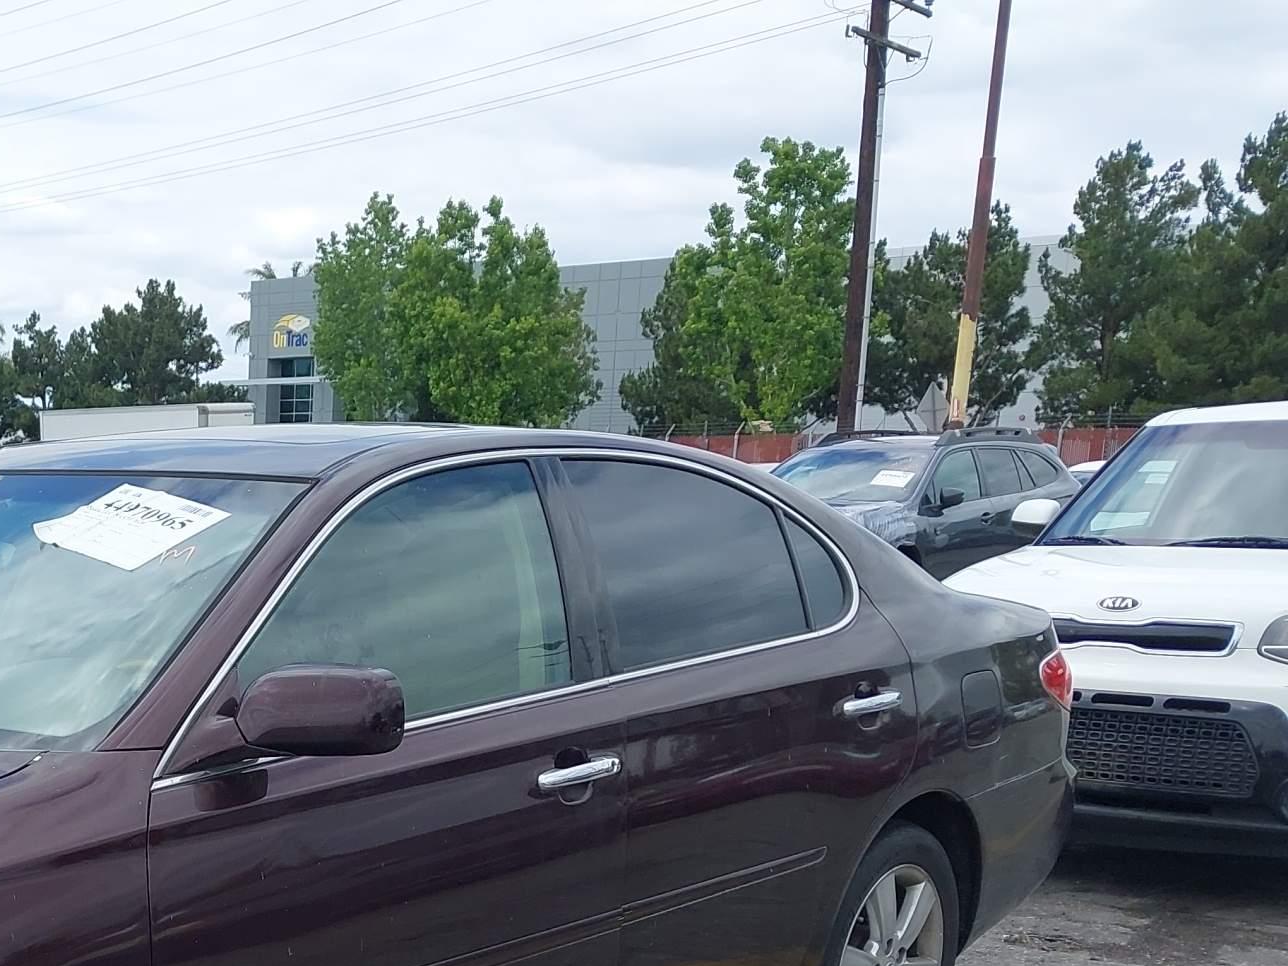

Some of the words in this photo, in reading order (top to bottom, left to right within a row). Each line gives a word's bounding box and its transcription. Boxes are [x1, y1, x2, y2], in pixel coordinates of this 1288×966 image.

[273, 330, 309, 349] OnTrac
[103, 499, 195, 530] 44970965
[1101, 597, 1133, 609] KIA
